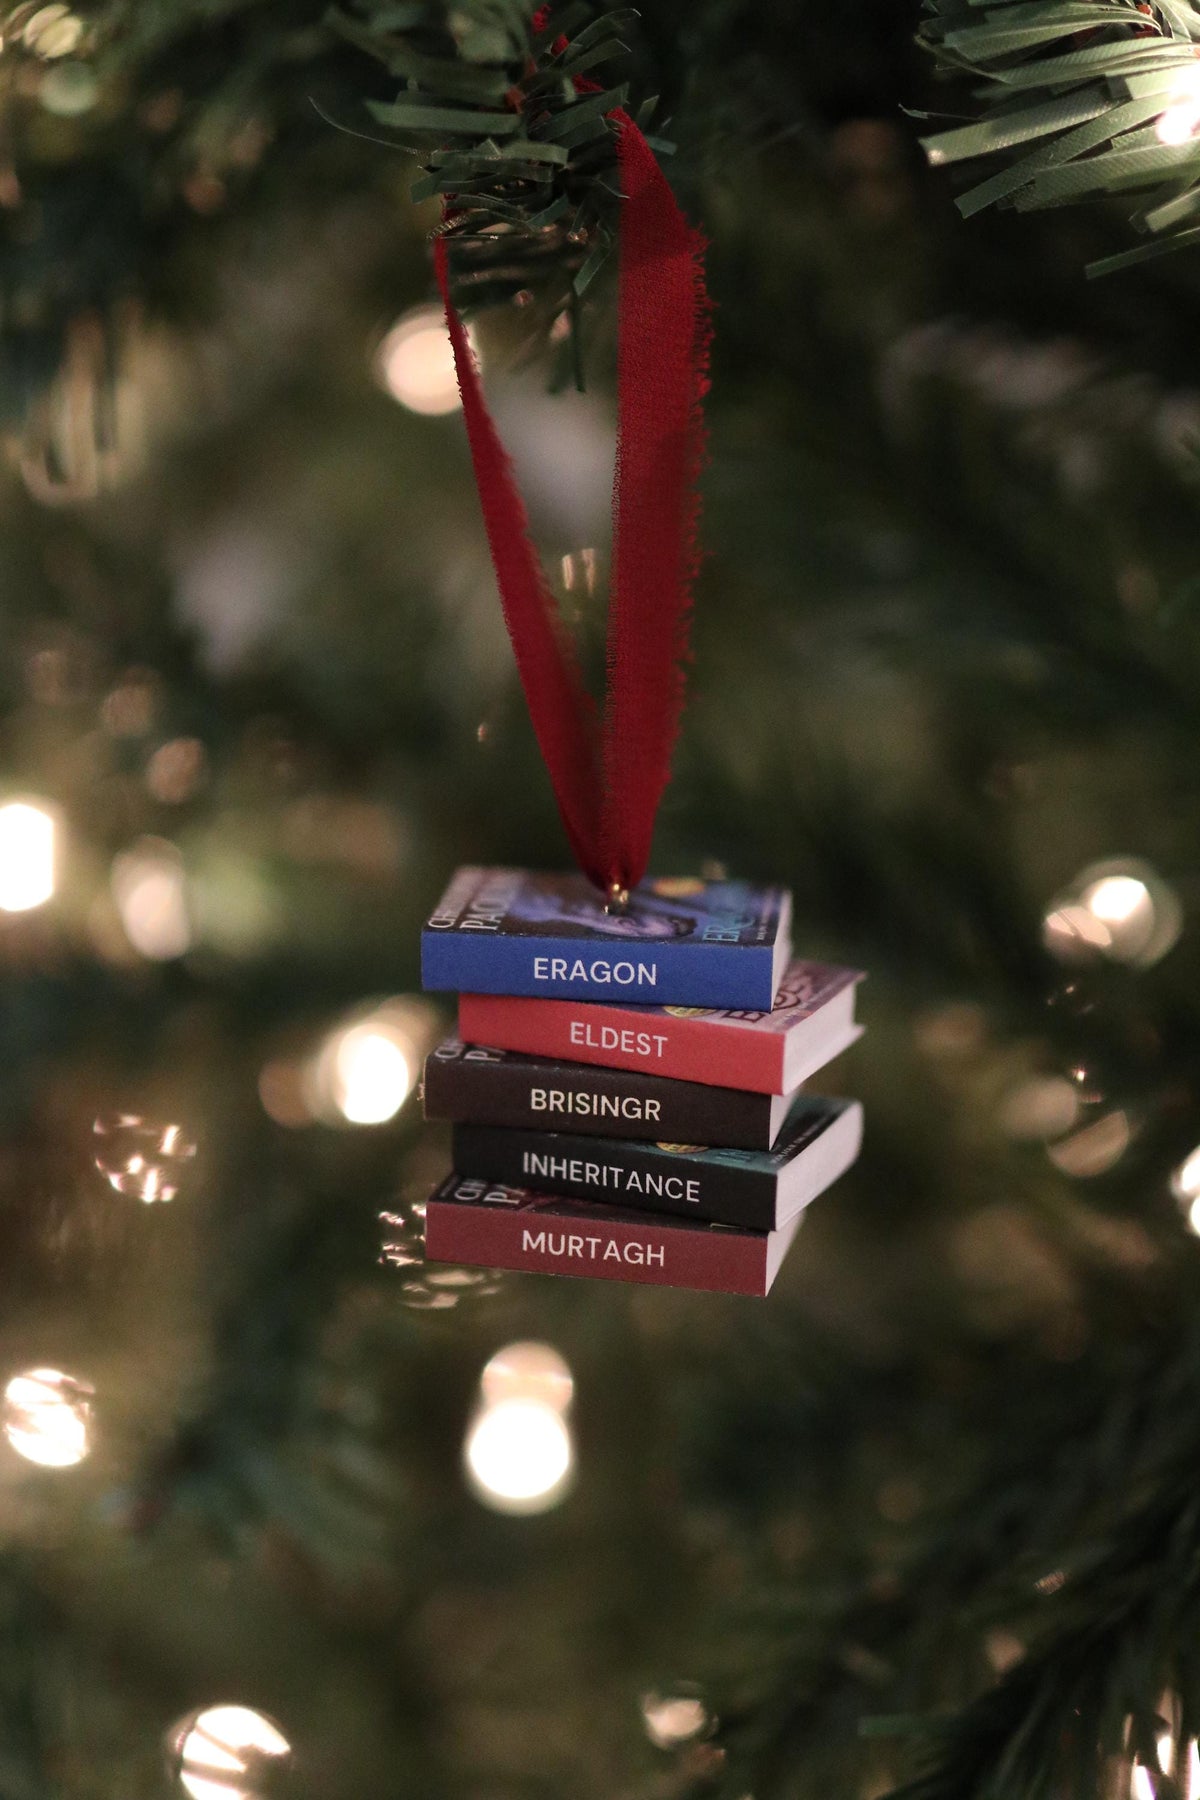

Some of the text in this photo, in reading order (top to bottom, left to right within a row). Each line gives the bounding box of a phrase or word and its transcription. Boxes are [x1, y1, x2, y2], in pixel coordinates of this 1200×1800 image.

[533, 957, 657, 986] ERAGON
[570, 1021, 669, 1058] ELDEST
[531, 1088, 661, 1121] BRISINGR
[523, 1152, 700, 1203] INHERITANCE
[522, 1229, 665, 1267] MURTAGH
